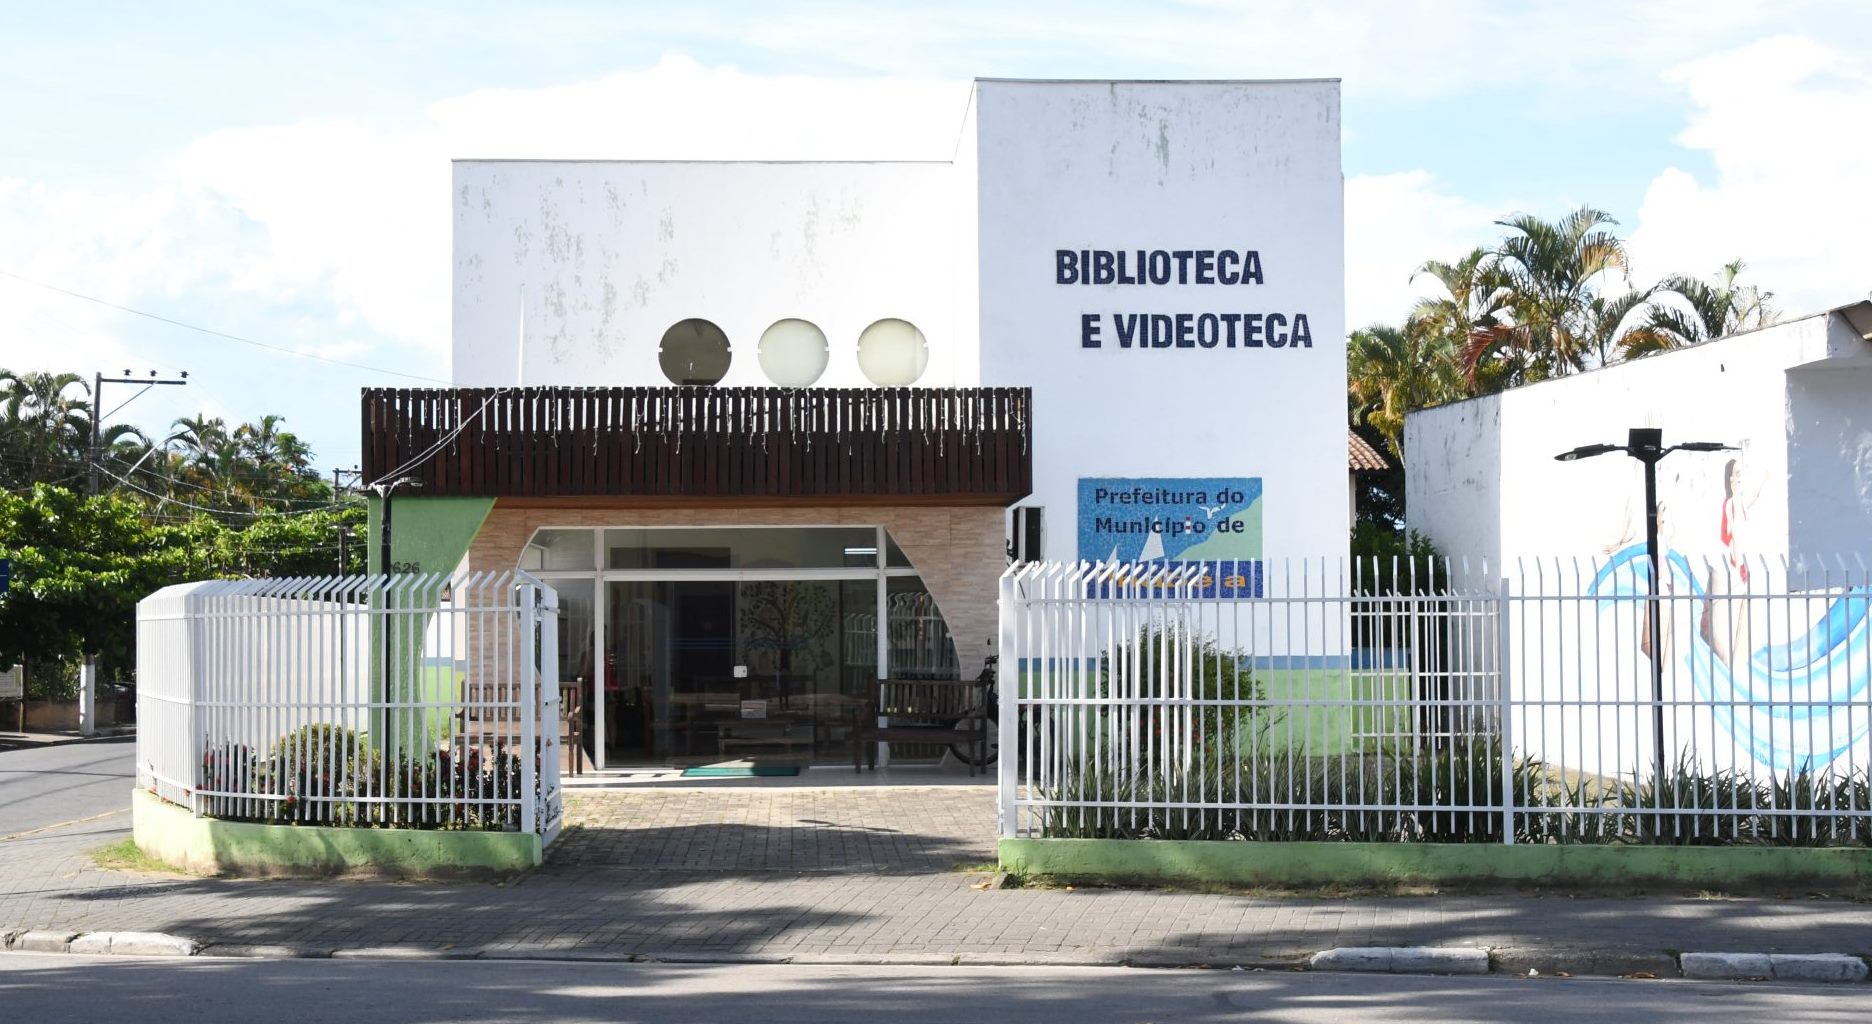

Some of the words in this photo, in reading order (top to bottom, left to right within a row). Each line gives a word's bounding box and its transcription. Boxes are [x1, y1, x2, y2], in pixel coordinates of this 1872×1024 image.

[1056, 249, 1264, 285] BIBLIOTECA
[1081, 313, 1102, 348] E
[1113, 313, 1313, 348] VIDEOTECA
[1095, 488, 1207, 504] Prefeitura
[1216, 488, 1245, 504] do
[1095, 516, 1206, 537] Município
[1216, 517, 1245, 533] de
